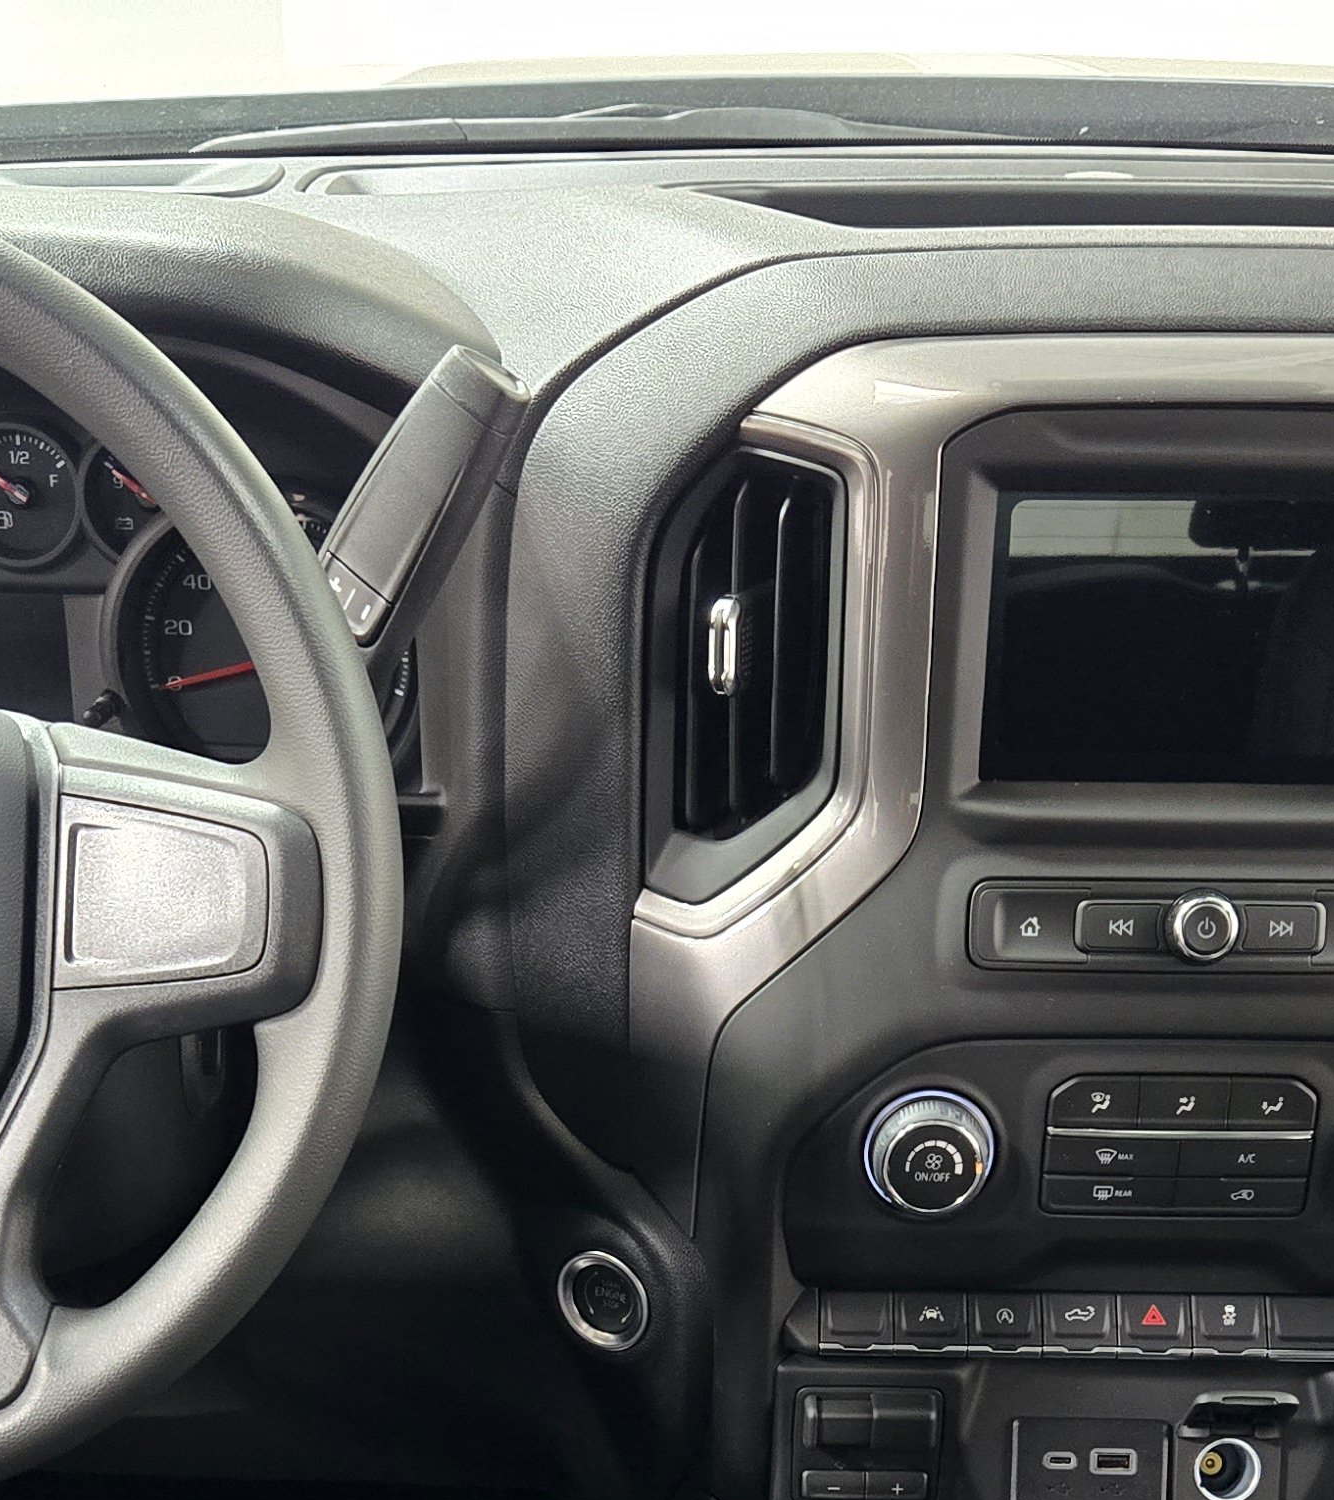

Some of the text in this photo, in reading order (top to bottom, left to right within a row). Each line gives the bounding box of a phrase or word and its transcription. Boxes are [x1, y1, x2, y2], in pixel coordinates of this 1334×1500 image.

[9, 451, 30, 465] 1/2
[49, 474, 60, 488] F
[183, 574, 212, 590] 40
[165, 619, 193, 636] 20
[168, 675, 183, 691] 0
[1118, 1153, 1134, 1161] MAX
[1238, 1153, 1257, 1164] A/C
[914, 1171, 951, 1183] ON/OFF
[1115, 1189, 1133, 1198] REAR
